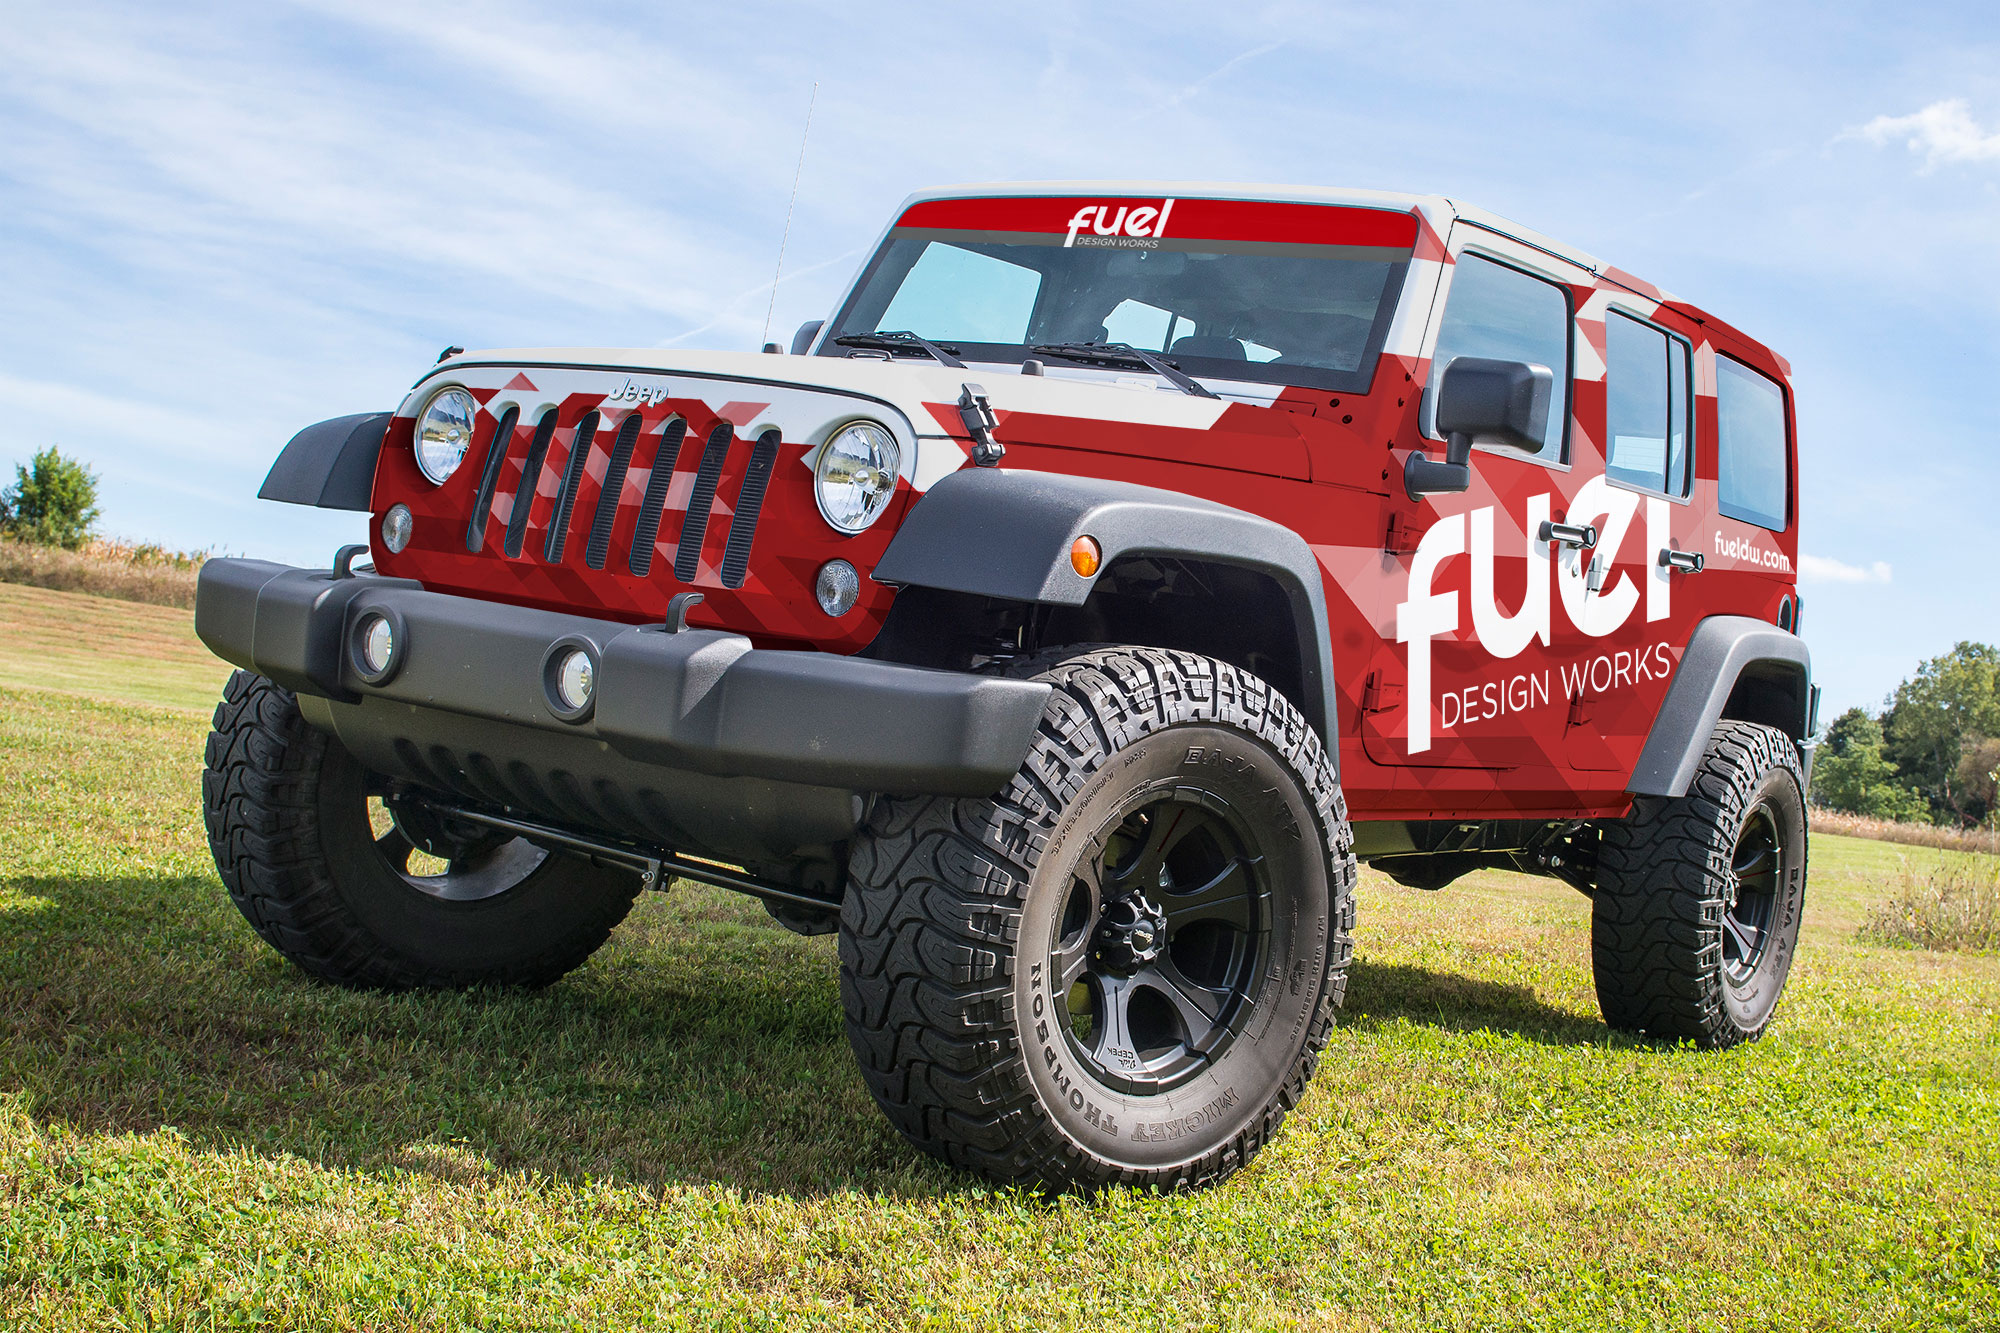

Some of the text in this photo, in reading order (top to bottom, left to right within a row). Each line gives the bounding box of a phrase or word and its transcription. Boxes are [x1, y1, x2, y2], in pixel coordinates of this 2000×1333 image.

[1064, 199, 1175, 247] fuel
[1076, 237, 1160, 249] DESIGN WORKS
[608, 376, 669, 408] Jeep
[1714, 530, 1790, 572] fueldw.com
[1396, 473, 1671, 756] fuel
[1441, 641, 1671, 729] DESIGN WORKS
[1030, 961, 1119, 1137] THOMPSON
[1107, 1047, 1134, 1060] CEPEK
[1130, 1086, 1240, 1143] MICKEY
